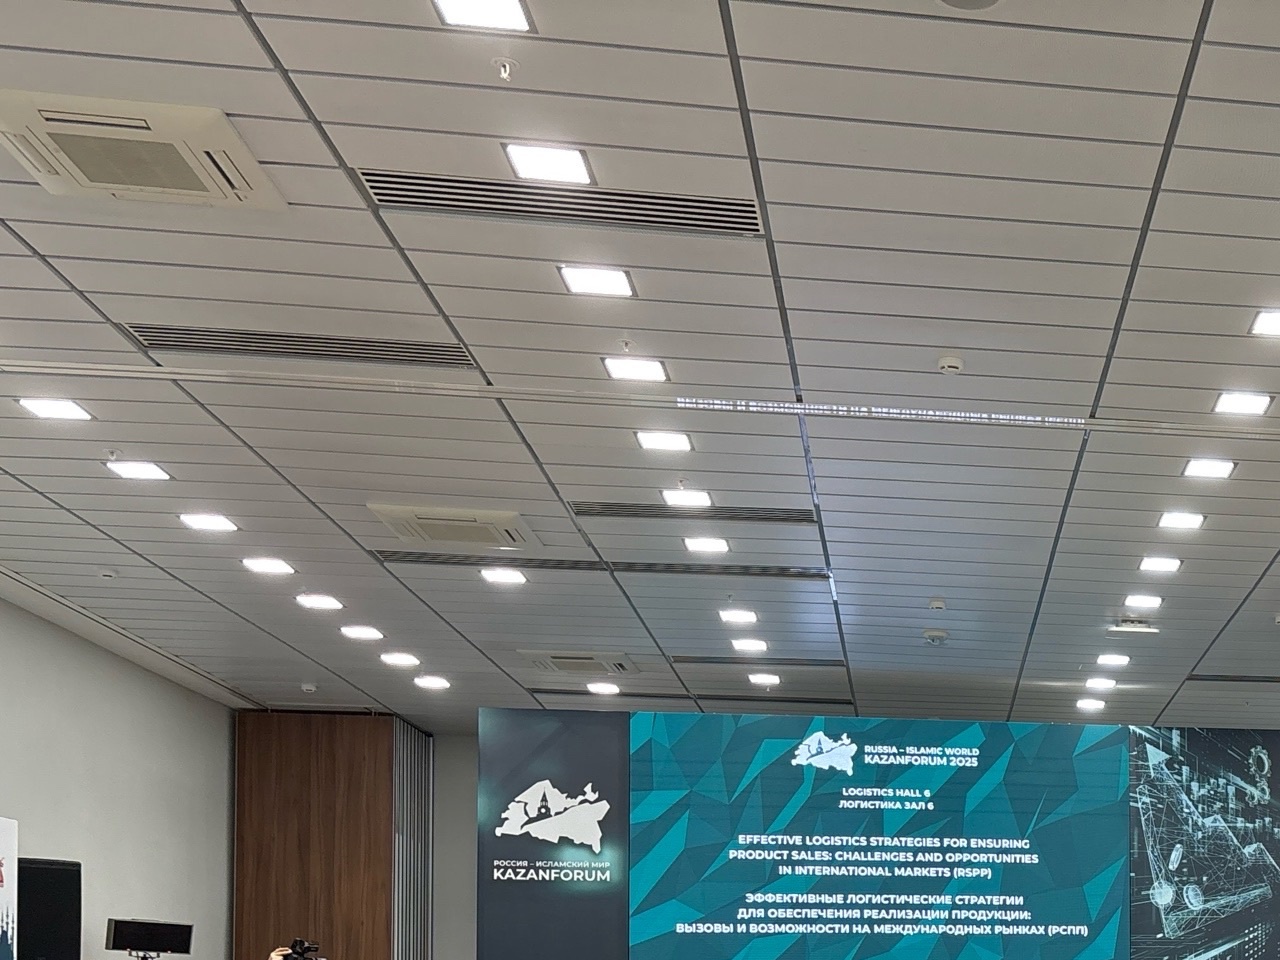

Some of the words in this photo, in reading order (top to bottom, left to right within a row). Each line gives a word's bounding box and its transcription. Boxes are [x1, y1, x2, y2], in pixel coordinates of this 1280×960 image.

[864, 745, 897, 754] RUSSIA
[906, 746, 943, 755] ISLAMIC
[944, 747, 980, 756] WORLD
[864, 755, 947, 766] KAZANFORUM
[950, 757, 979, 767] 2025
[842, 787, 894, 797] LOGISTICS
[895, 788, 921, 798] HALL
[924, 789, 931, 798] 6
[839, 800, 902, 810] ЛОГИСТИКА
[903, 801, 925, 810] ЗАЛ
[927, 802, 934, 811] 6
[738, 834, 802, 845] EFFECTIVE
[806, 835, 867, 846] LOGISTICS
[869, 837, 941, 847] STRATEGIES
[943, 838, 968, 848] FOR
[970, 838, 1030, 849] ENSURING
[729, 850, 789, 860] PRODUCT
[791, 850, 832, 861] SALES:
[834, 851, 914, 861] CHALLENGES
[915, 852, 943, 862] AND
[945, 853, 1039, 864] OPPORTUNITIES
[536, 860, 590, 868] ИСЛАМСКИЙ
[493, 868, 610, 881] KAZANFORUM
[778, 866, 792, 875] IN
[795, 866, 892, 876] INTERNATIONAL
[894, 867, 951, 877] MARKETS
[953, 868, 992, 879] (RSPP)
[745, 893, 844, 904] ЭФФЕКТИВНЫЕ
[846, 894, 952, 904] ЛОГИСТИЧЕСКИЕ
[955, 895, 1024, 905] СТРАТЕГИИ
[737, 908, 765, 919] ДЛЯ
[767, 908, 861, 919] ОБЕСПЕЧЕНИЯ
[864, 909, 948, 921] РЕАЛИЗАЦИИ
[951, 910, 1031, 921] ПРОДУКЦИИ:
[676, 923, 734, 933] ВЫЗОВЫ
[737, 924, 746, 933] И
[749, 924, 849, 934] ВОЗМОЖНОСТИ
[852, 924, 871, 934] НА
[874, 924, 992, 936] МЕЖДУНАРОДНЫХ
[995, 925, 1045, 935] РЫНКАХ
[1047, 925, 1088, 937] (РСПП)
